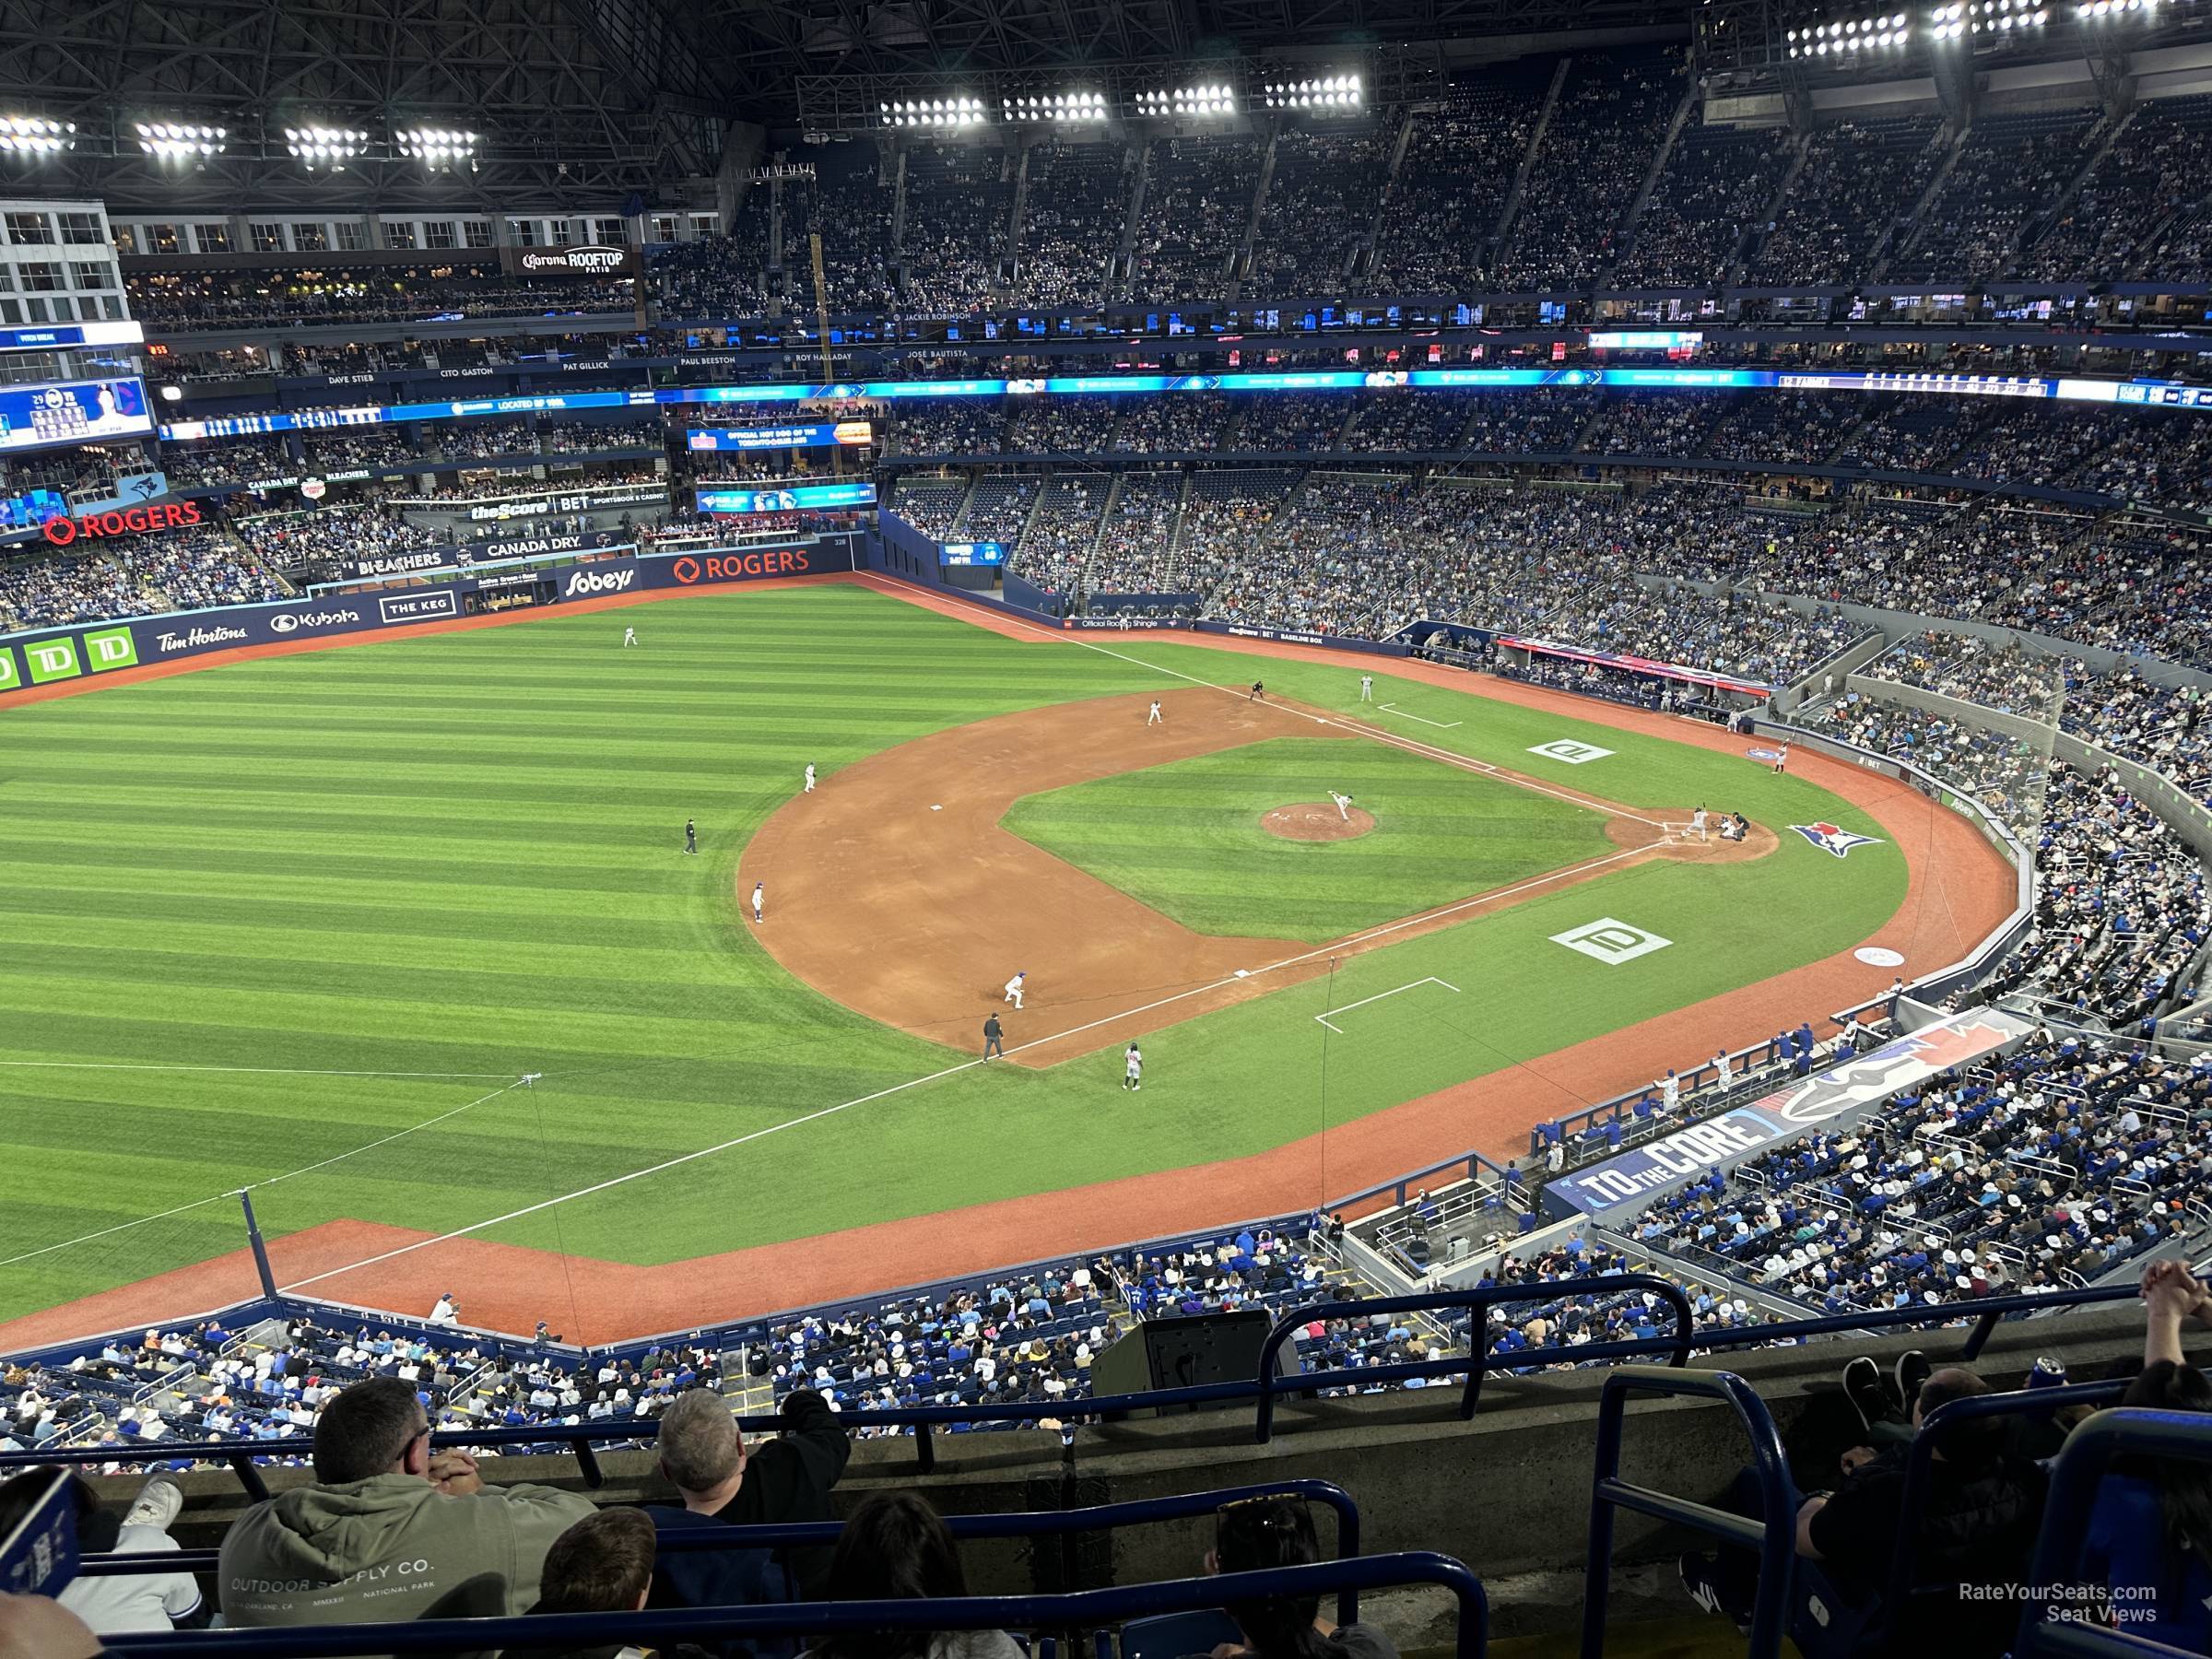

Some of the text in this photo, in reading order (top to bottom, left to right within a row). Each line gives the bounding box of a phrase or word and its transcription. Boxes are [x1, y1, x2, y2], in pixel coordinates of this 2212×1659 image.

[523, 253, 623, 269] Corona ROOFTOP
[701, 356, 735, 364] BEESTON
[907, 349, 967, 359] JOSÉ BAUTISTA
[441, 368, 493, 378] CITO GASTON
[578, 361, 608, 370] GILLICK
[329, 374, 374, 384] DAVE STIEB
[499, 399, 533, 409] LOCATED
[248, 478, 282, 489] CANADA
[326, 470, 369, 480] BLEACHERS
[471, 502, 547, 519] theScore
[561, 496, 589, 511] BET
[82, 500, 201, 537] ROGERS
[488, 539, 549, 557] CANADA
[706, 550, 809, 578] ROGERS
[565, 569, 634, 596] Sobeys
[389, 599, 447, 614] THE KEG
[300, 609, 359, 627] Kubota
[1133, 619, 1158, 628] Shingle
[156, 627, 247, 652] Tim Hortons
[1281, 634, 1309, 643] BASELINE
[90, 636, 130, 662] TD
[31, 646, 73, 673] TD
[1568, 926, 1646, 953] TD
[1578, 1115, 1768, 1203] TO THE CORE
[231, 1578, 310, 1594] OUTDOOR
[398, 1559, 434, 1574] CO.
[363, 1586, 407, 1598] NATIONAL
[411, 1582, 435, 1590] PARK
